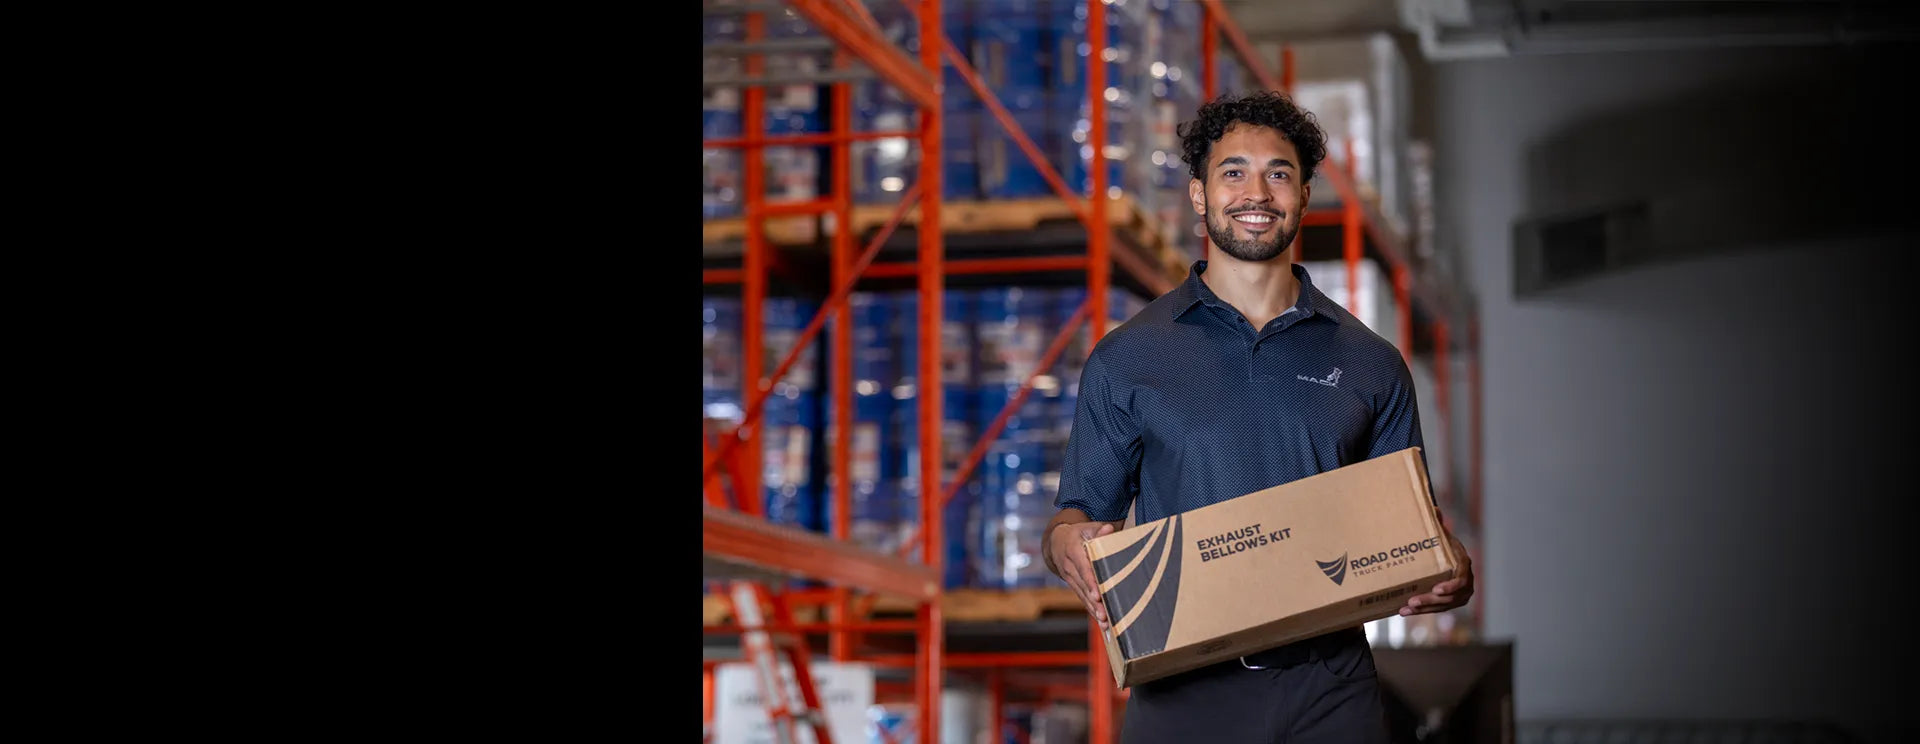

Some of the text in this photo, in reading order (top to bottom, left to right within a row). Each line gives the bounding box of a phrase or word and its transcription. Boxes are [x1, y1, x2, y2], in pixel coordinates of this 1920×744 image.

[1197, 523, 1261, 551] EXHAUST
[1200, 527, 1291, 562] BELLOWS KIT
[1350, 536, 1440, 570] ROAD CHOICE
[1353, 555, 1416, 577] TRUCK PARTS
